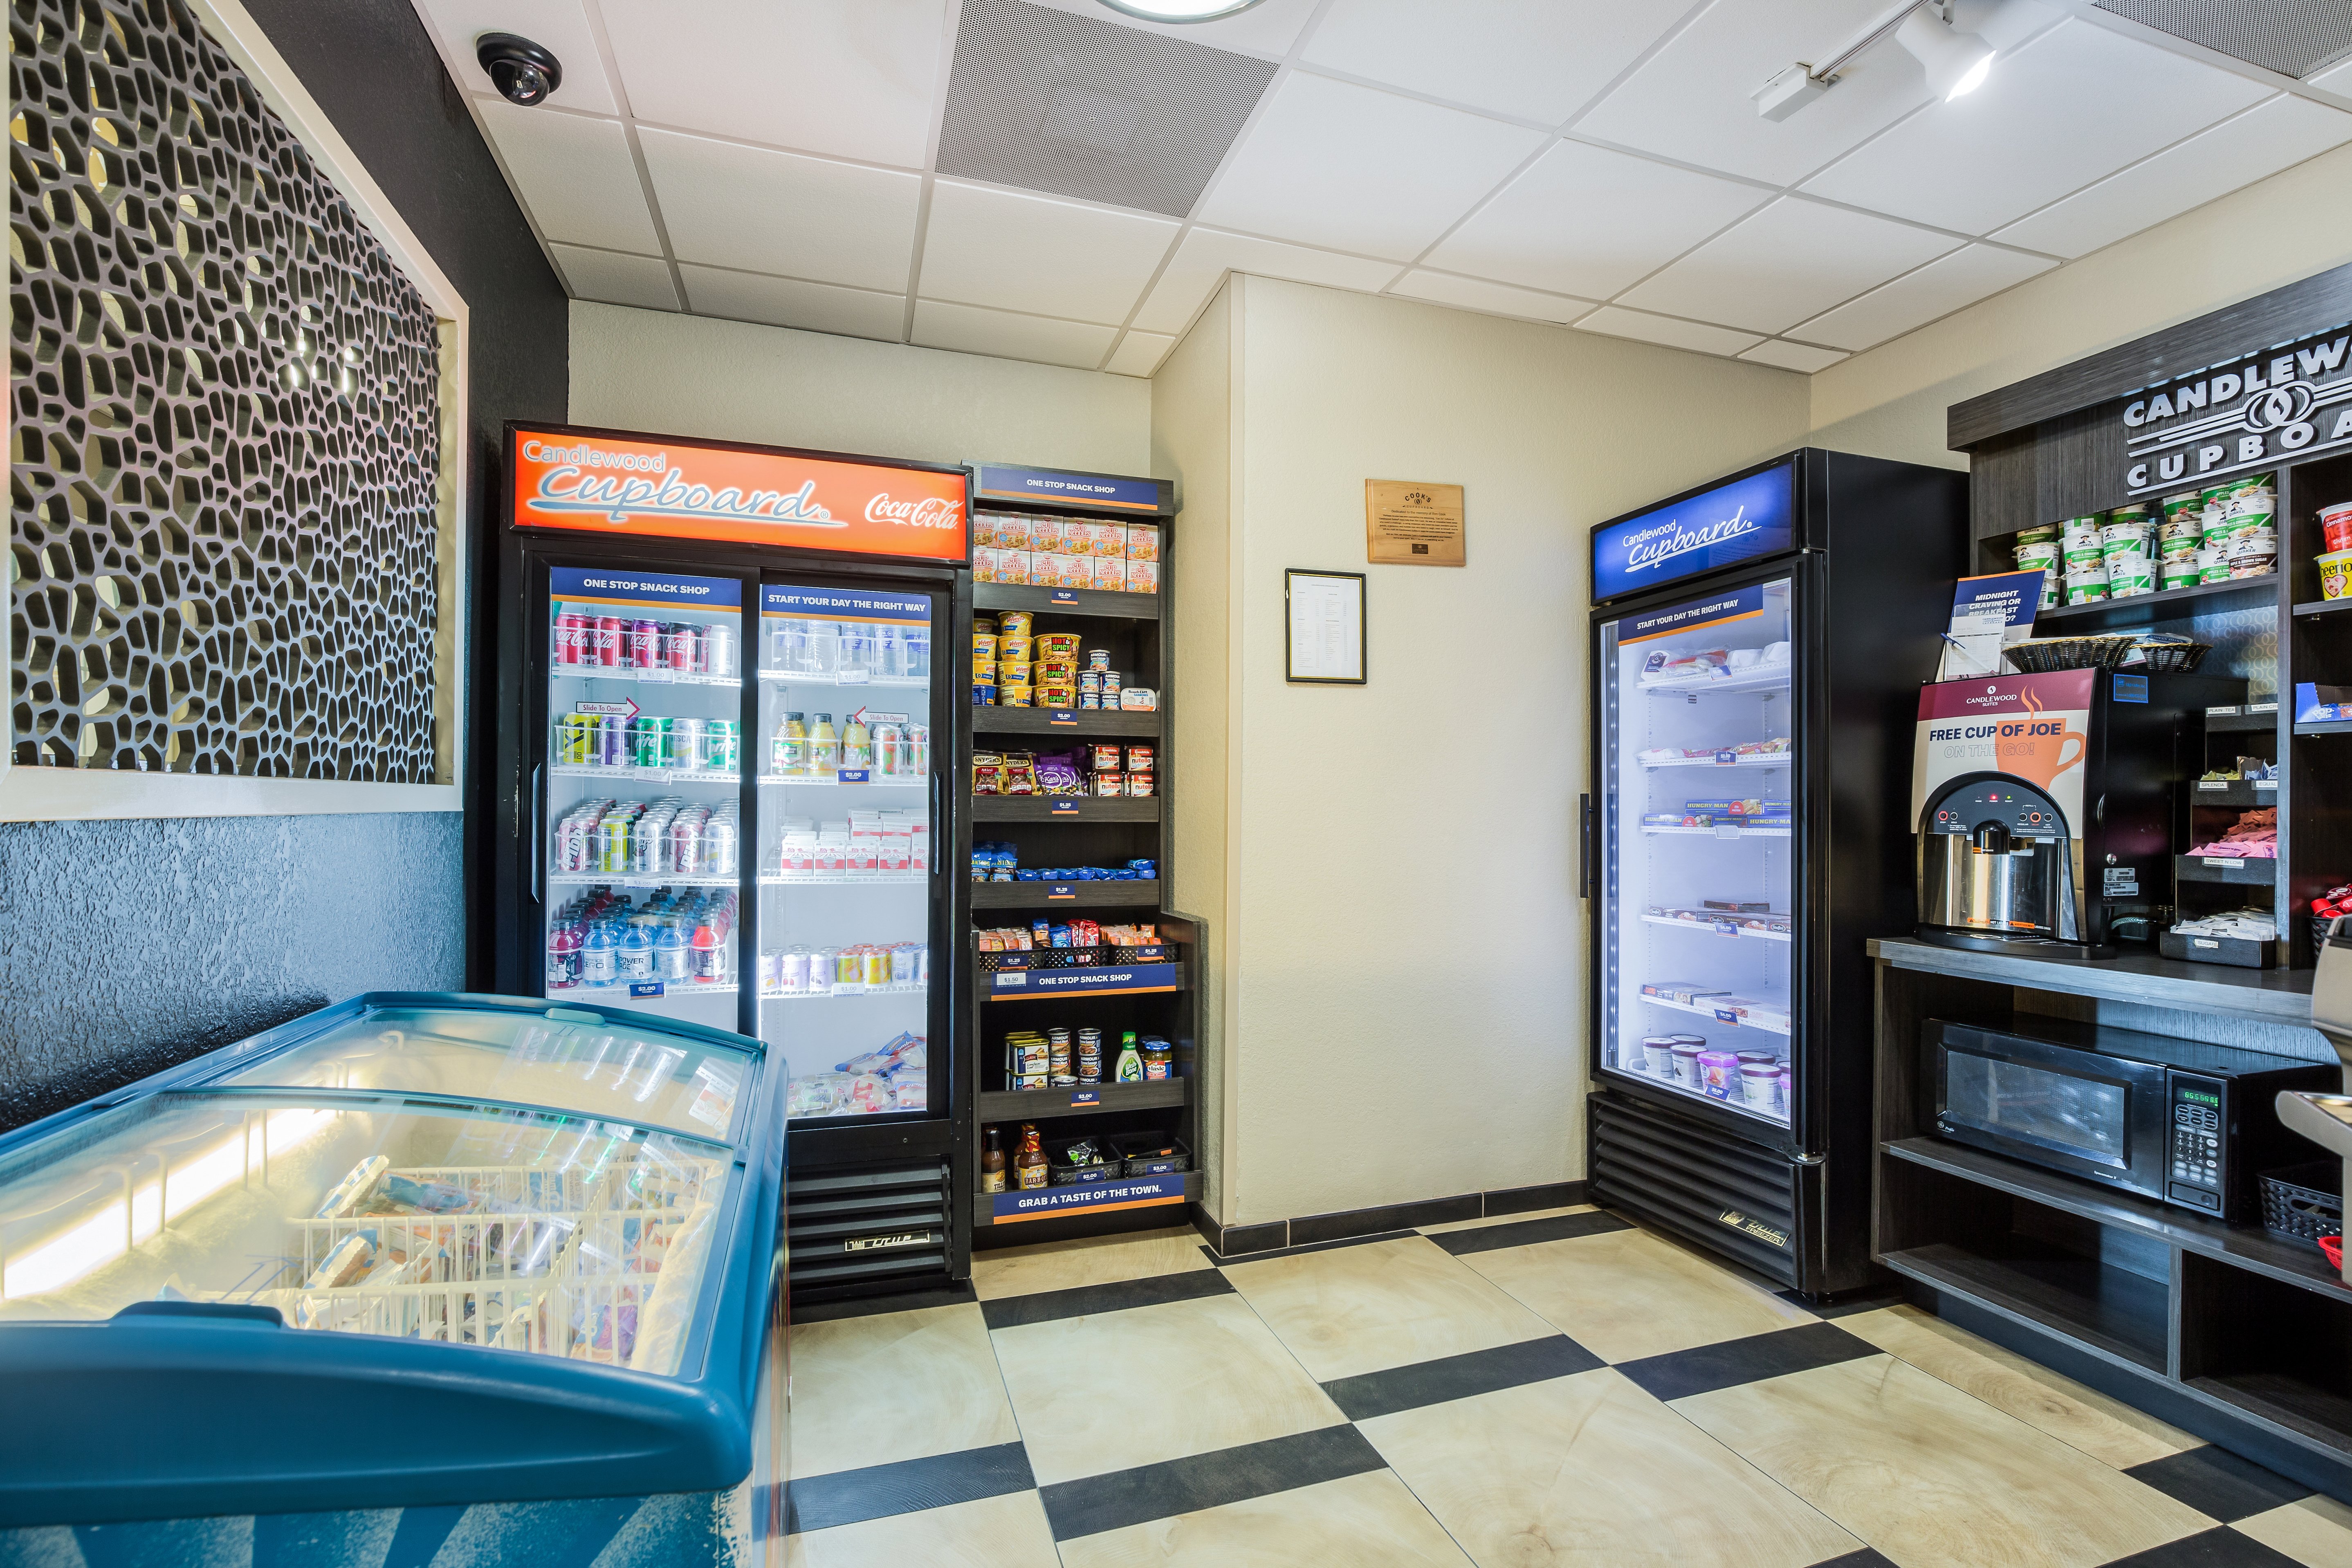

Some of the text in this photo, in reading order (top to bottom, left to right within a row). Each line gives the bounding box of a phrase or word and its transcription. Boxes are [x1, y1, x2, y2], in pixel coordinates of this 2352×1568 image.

[525, 442, 664, 471] Candlewood
[541, 468, 819, 520] Cupboard
[1066, 482, 1093, 492] SNACK
[1094, 485, 1115, 494] SHOP
[1405, 492, 1431, 502] COOK'S
[864, 493, 964, 529] Coca-Cola
[2326, 516, 2352, 527] Cinnamo
[1623, 519, 1676, 547] Candlewood
[1628, 505, 1747, 568] Cupboard
[2333, 536, 2351, 545] Gluten
[2320, 563, 2352, 577] heerio
[584, 579, 710, 595] ONE STOP SNACK SHOP
[768, 594, 926, 612] START YOUR DAY THE RIGHT WAY
[1975, 590, 2019, 601] MIDNIGHT
[1969, 601, 2006, 610] CRAVING
[1637, 599, 1739, 630] START YOUR DAY THE RIGHT WAY
[1966, 694, 2017, 704] CANDLEWOOD
[1929, 722, 2062, 742] FREE CUP OF JOE
[1944, 743, 2035, 759] ON THE GO!
[1039, 977, 1056, 985] ONE
[1080, 975, 1109, 983] SNACK
[1126, 1067, 1137, 1076] Bone
[2094, 1170, 2113, 1179] Spacemaker
[1018, 1197, 1048, 1208] GRAB
[1060, 1193, 1091, 1203] TASTE
[1093, 1191, 1107, 1199] OF
[1108, 1188, 1128, 1198] THE
[1130, 1184, 1162, 1195] TOWN.
[1746, 1226, 1780, 1243] FREEZER
